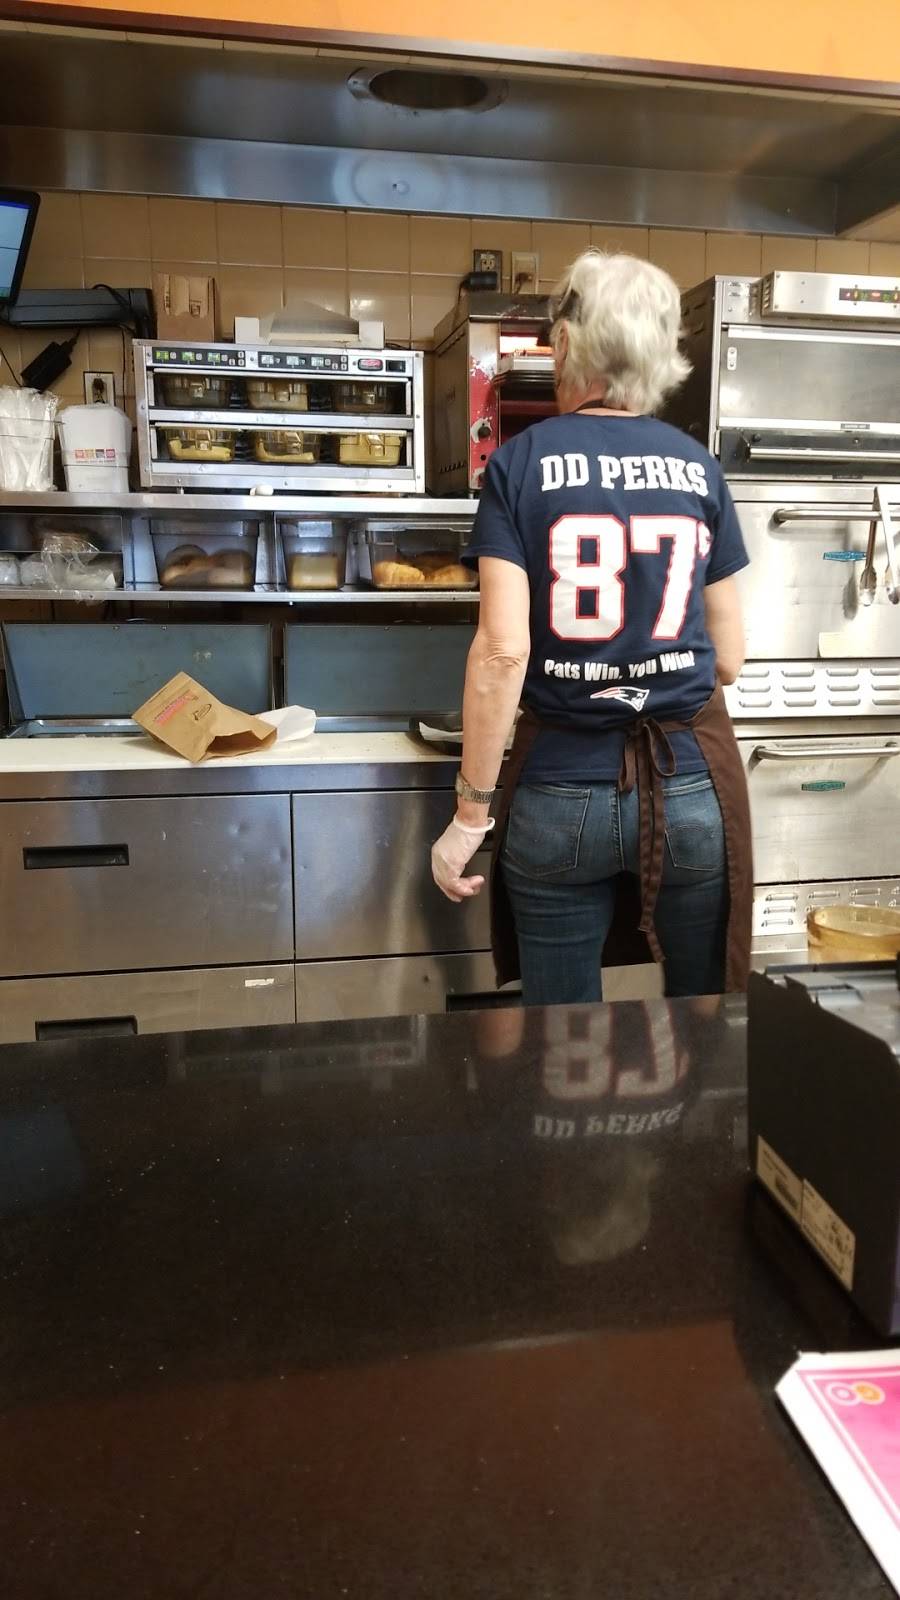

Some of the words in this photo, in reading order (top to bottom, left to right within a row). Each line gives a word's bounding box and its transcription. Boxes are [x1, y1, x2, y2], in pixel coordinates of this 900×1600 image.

[540, 453, 590, 491] DD
[598, 455, 709, 497] PERKS
[544, 659, 581, 680] Pats
[659, 650, 696, 673] Win!
